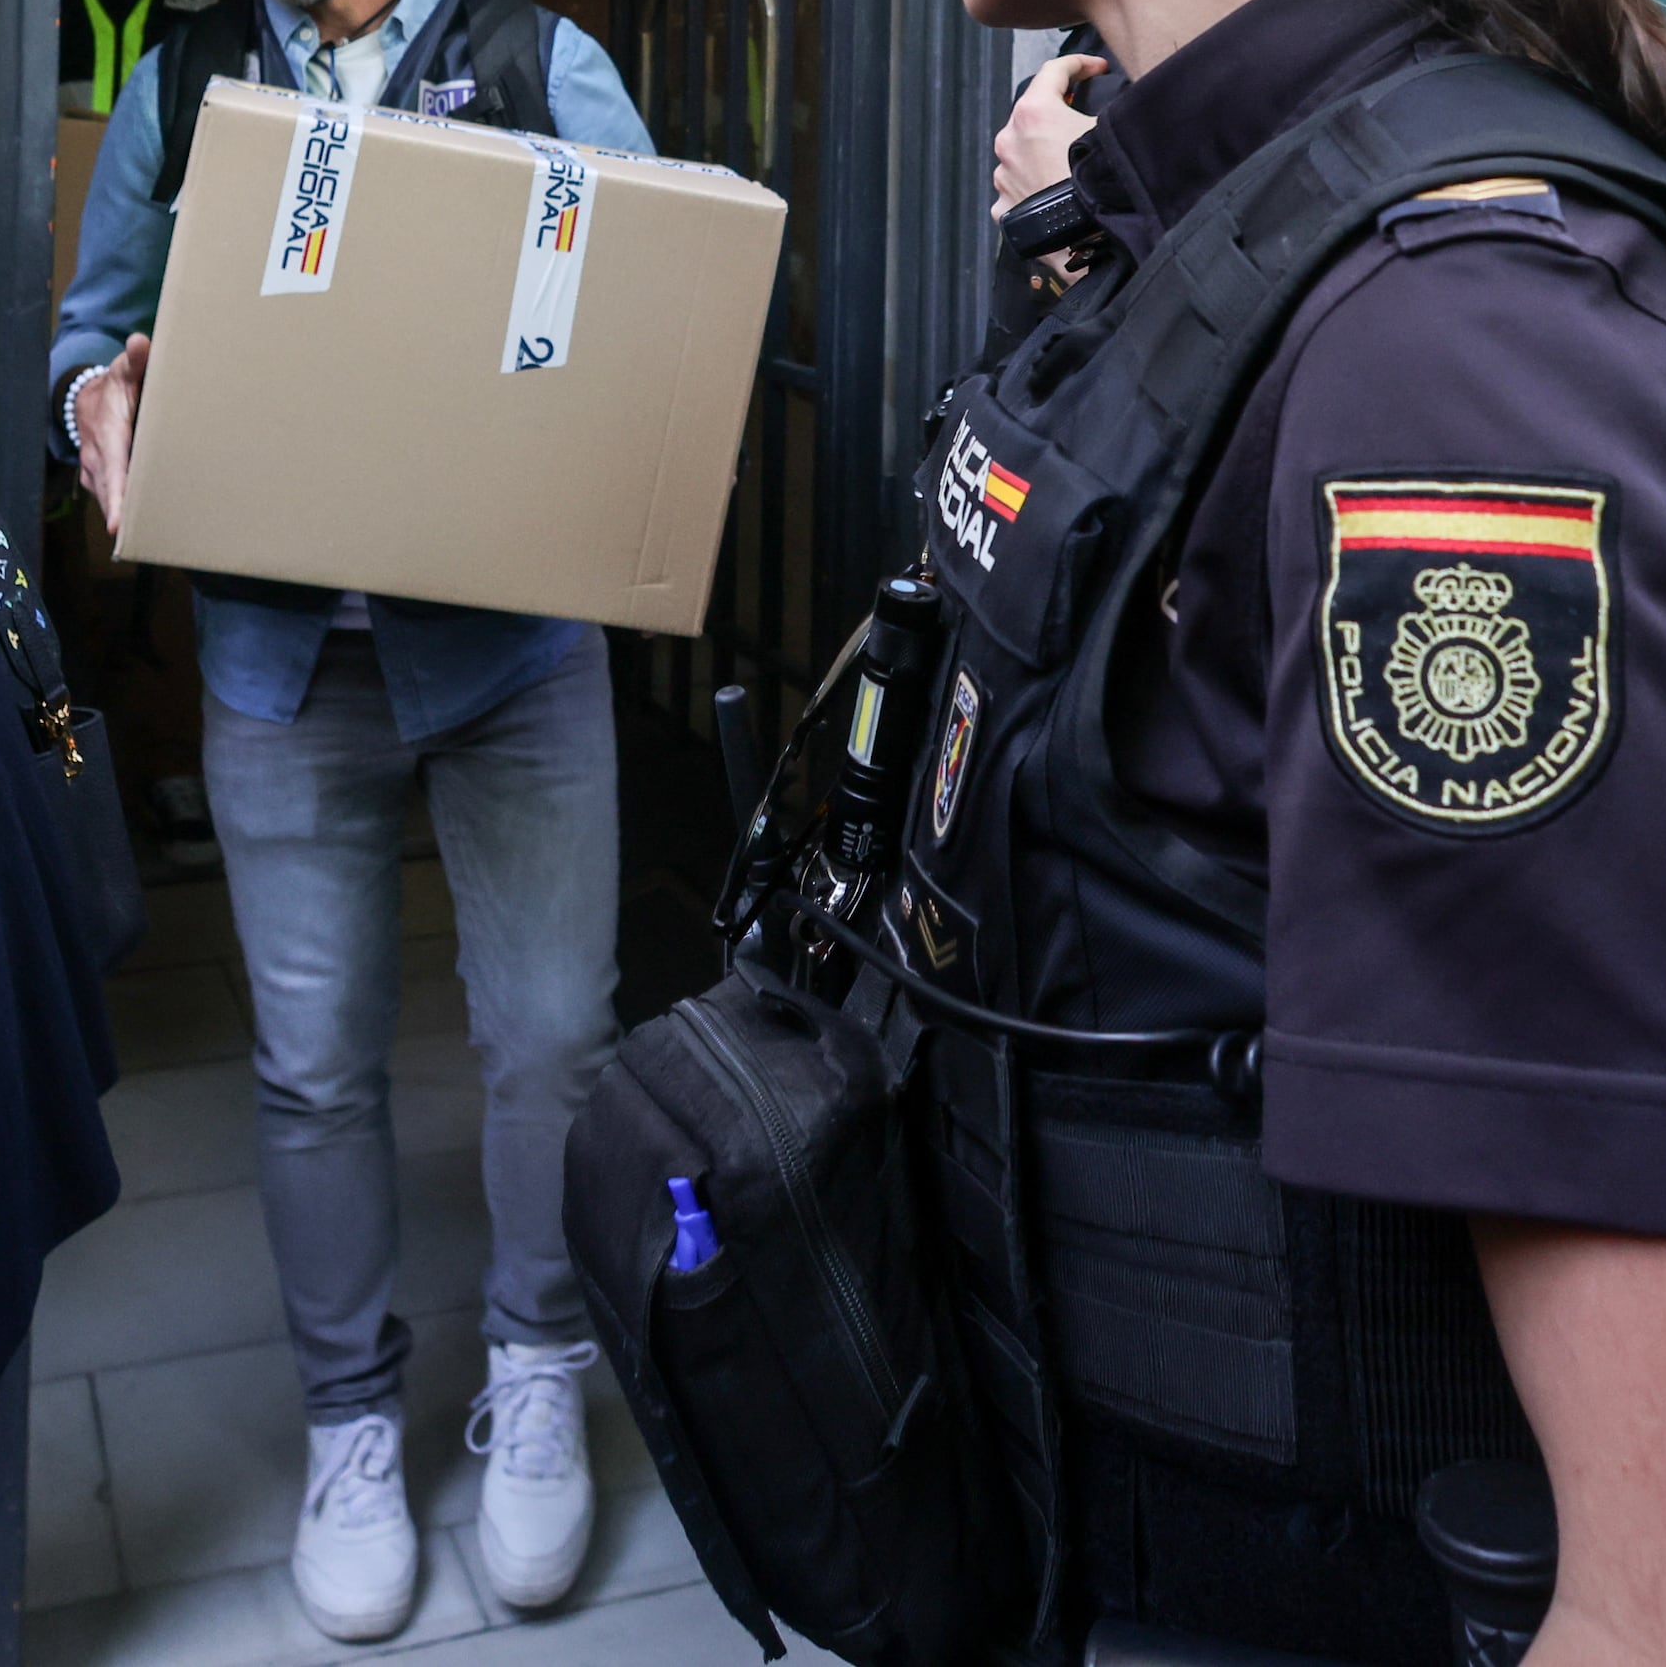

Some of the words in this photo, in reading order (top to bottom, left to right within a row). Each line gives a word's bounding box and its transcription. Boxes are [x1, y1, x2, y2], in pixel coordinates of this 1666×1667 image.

[281, 119, 329, 270] ACIONAL
[1335, 620, 1419, 795] POLICIA
[1441, 636, 1596, 809] NACIONAL
